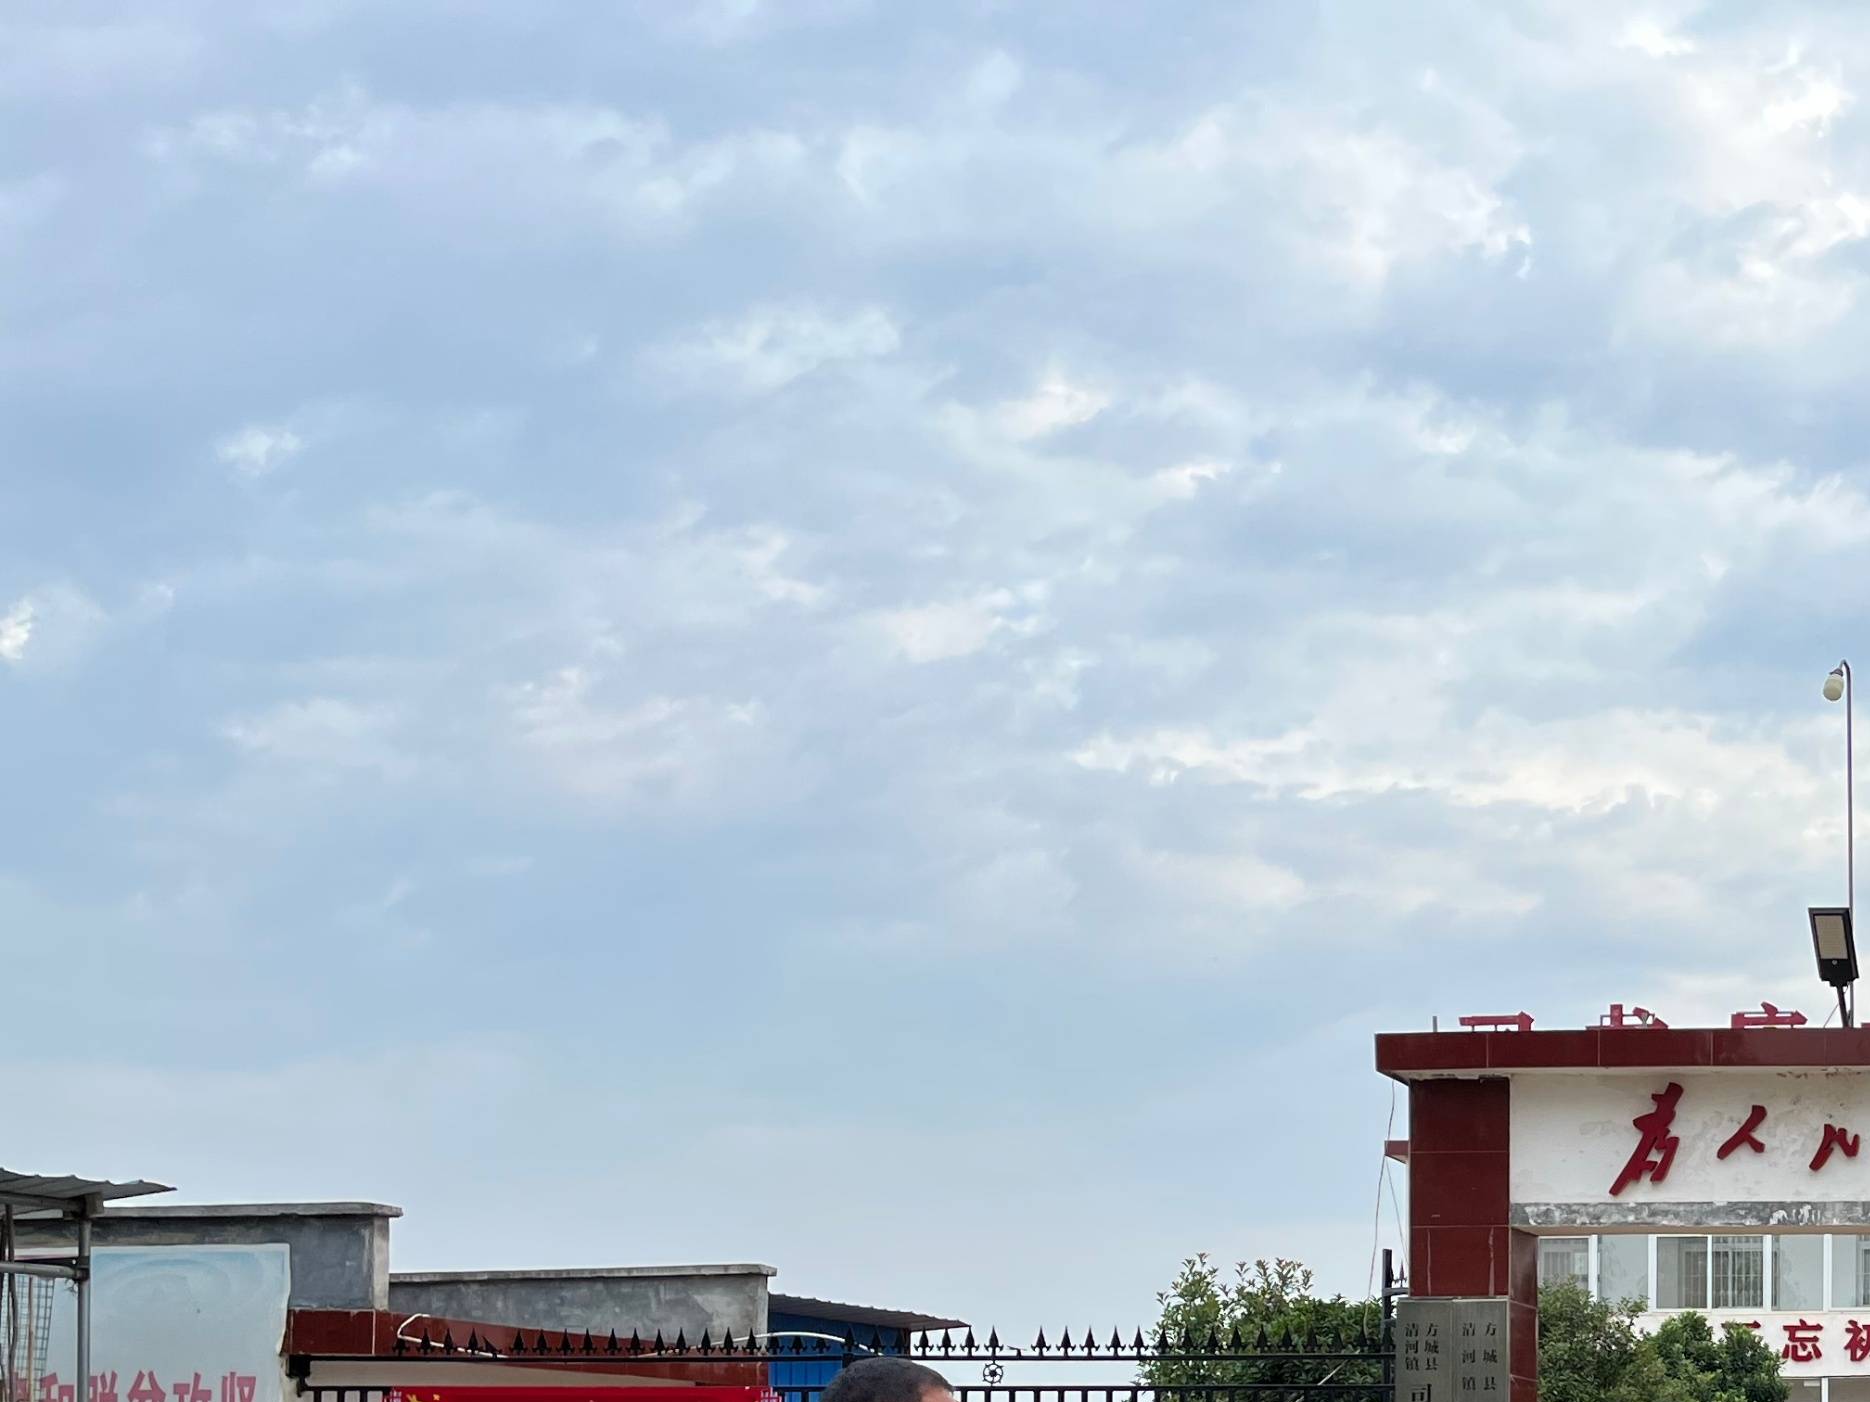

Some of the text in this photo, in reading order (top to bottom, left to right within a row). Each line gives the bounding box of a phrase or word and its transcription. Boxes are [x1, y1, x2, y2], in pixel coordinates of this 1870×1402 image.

[1404, 1322, 1420, 1373] 清河镇
[1424, 1322, 1440, 1372] 方城县
[1461, 1322, 1477, 1392] 清河镇
[1483, 1322, 1499, 1392] 方城县
